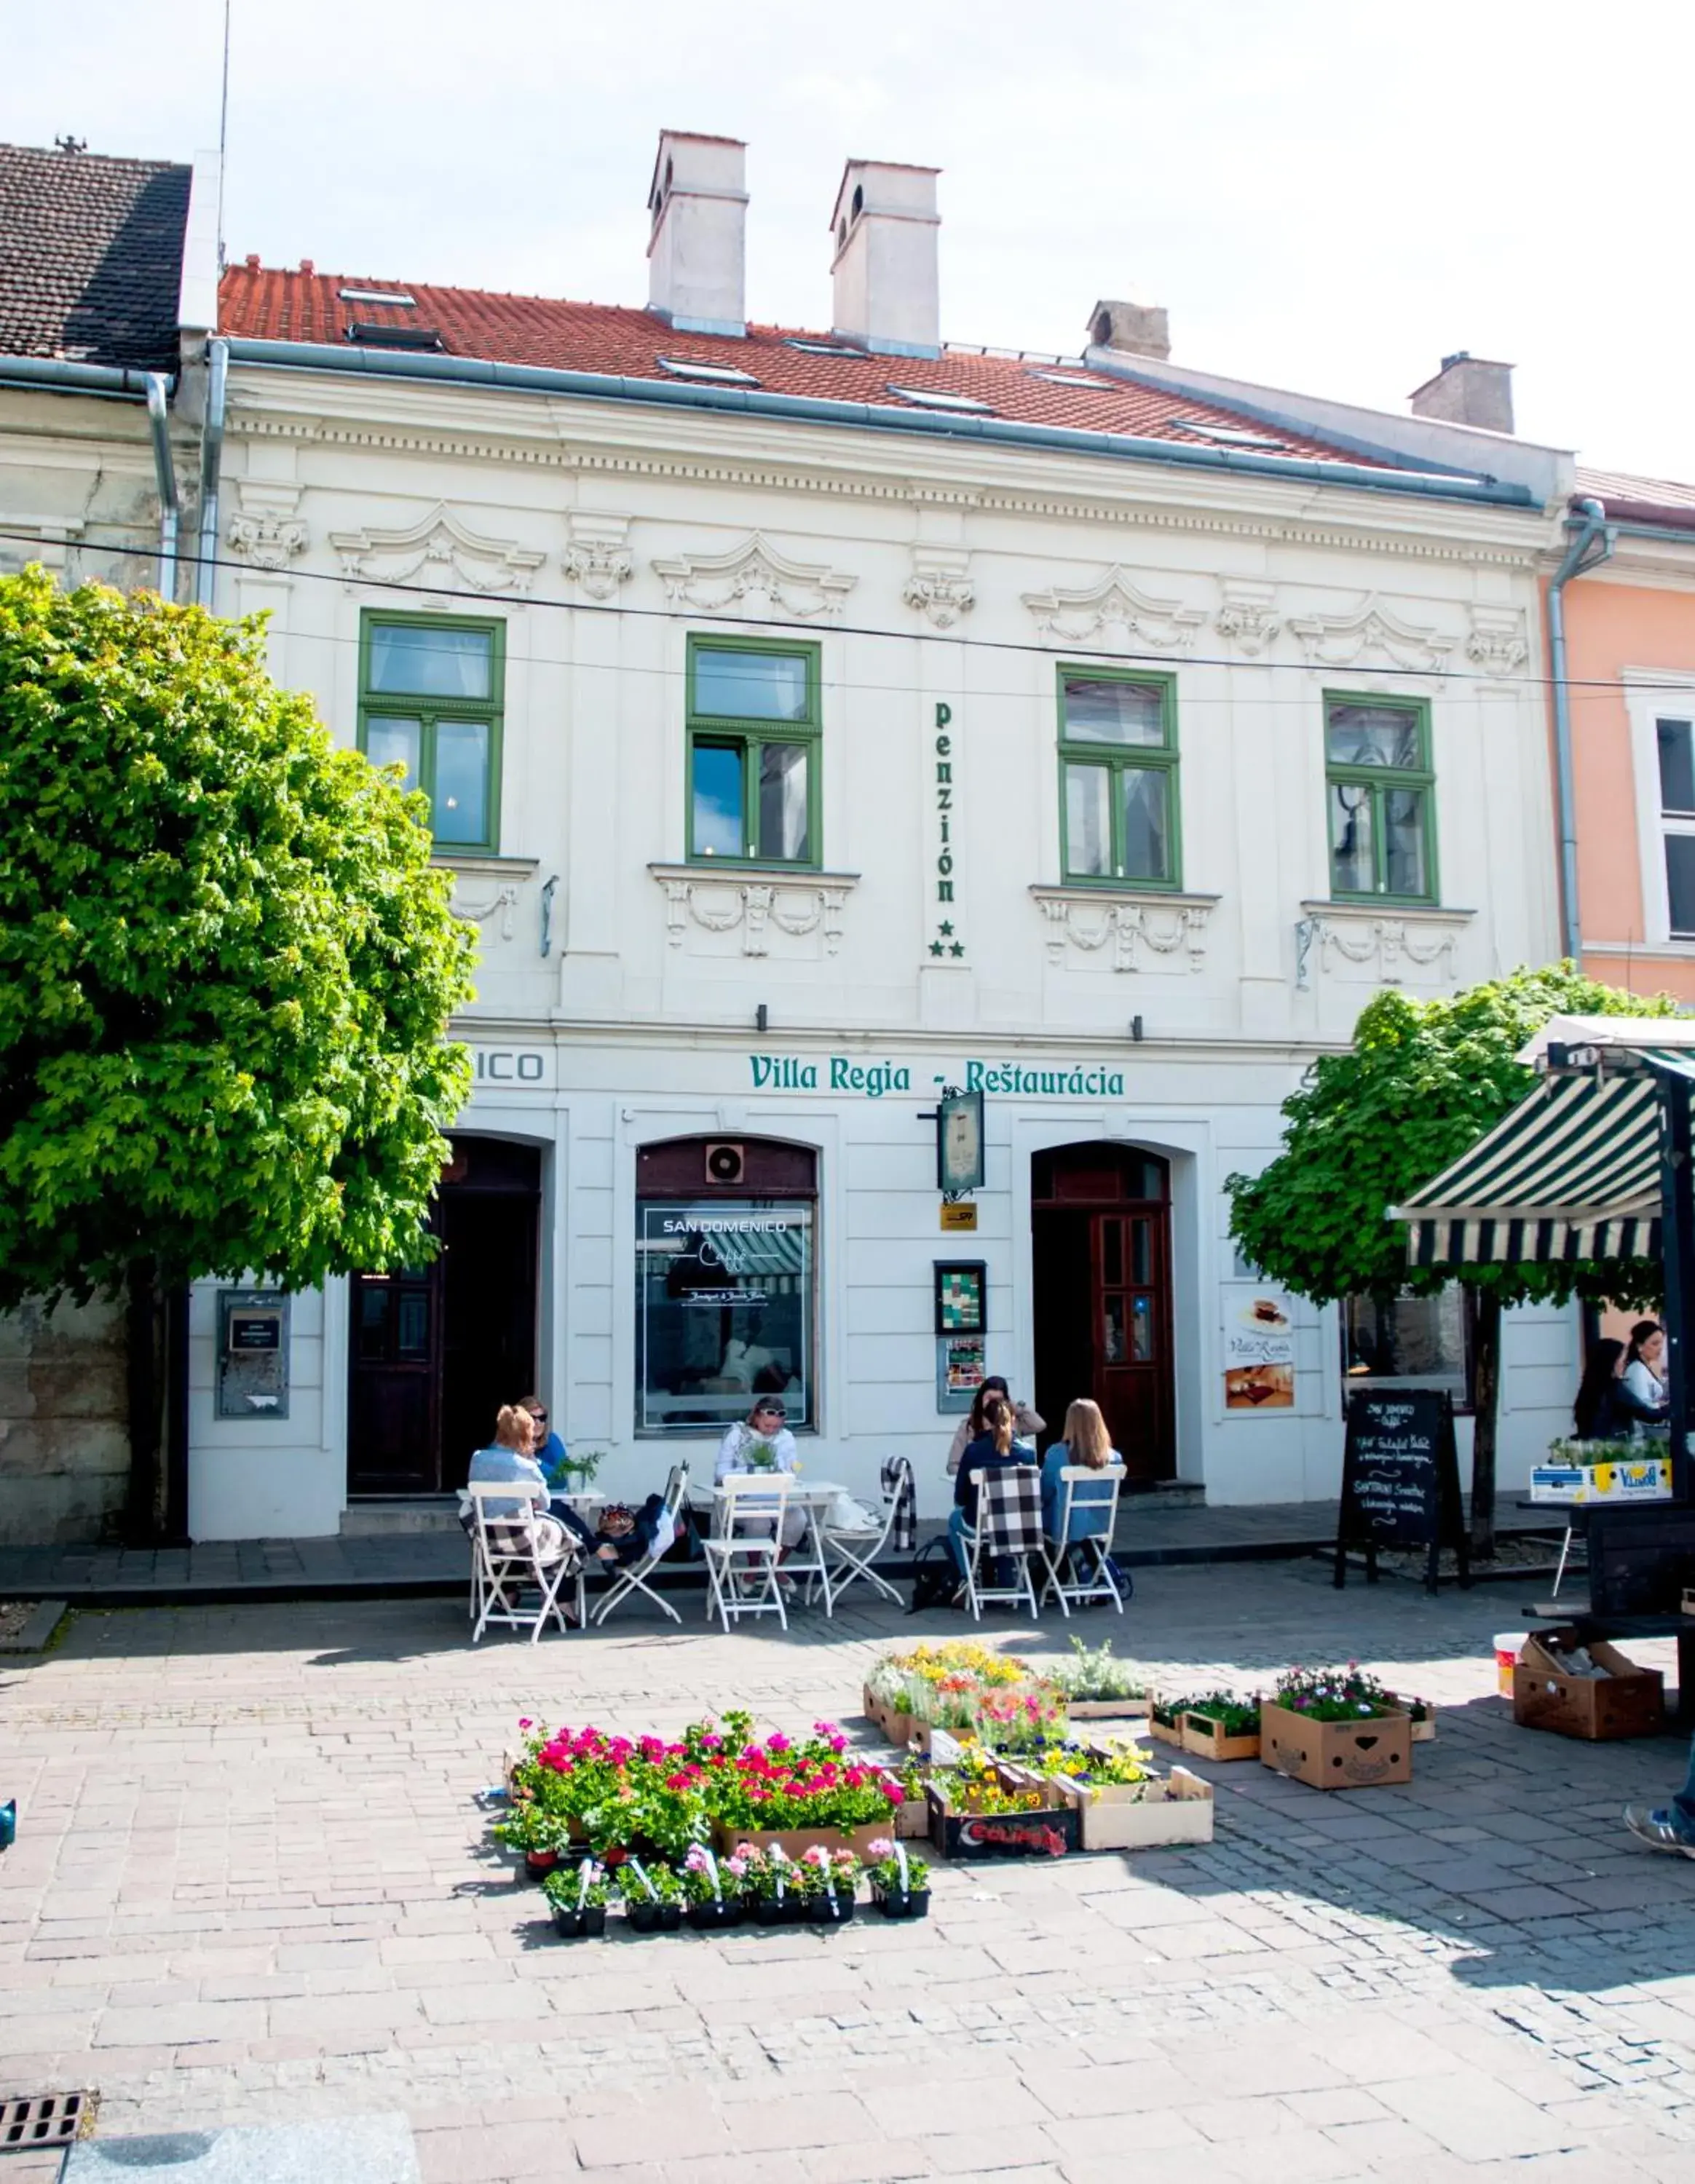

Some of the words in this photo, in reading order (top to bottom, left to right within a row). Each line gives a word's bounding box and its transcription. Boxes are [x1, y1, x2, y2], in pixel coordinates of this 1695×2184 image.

[478, 1053, 543, 1080] ICO
[750, 1056, 817, 1088] Villa
[830, 1057, 910, 1097] Regia
[966, 1061, 1124, 1096] Reštaurácia
[663, 1220, 697, 1233] SAN
[700, 1220, 786, 1233] DOMENICO
